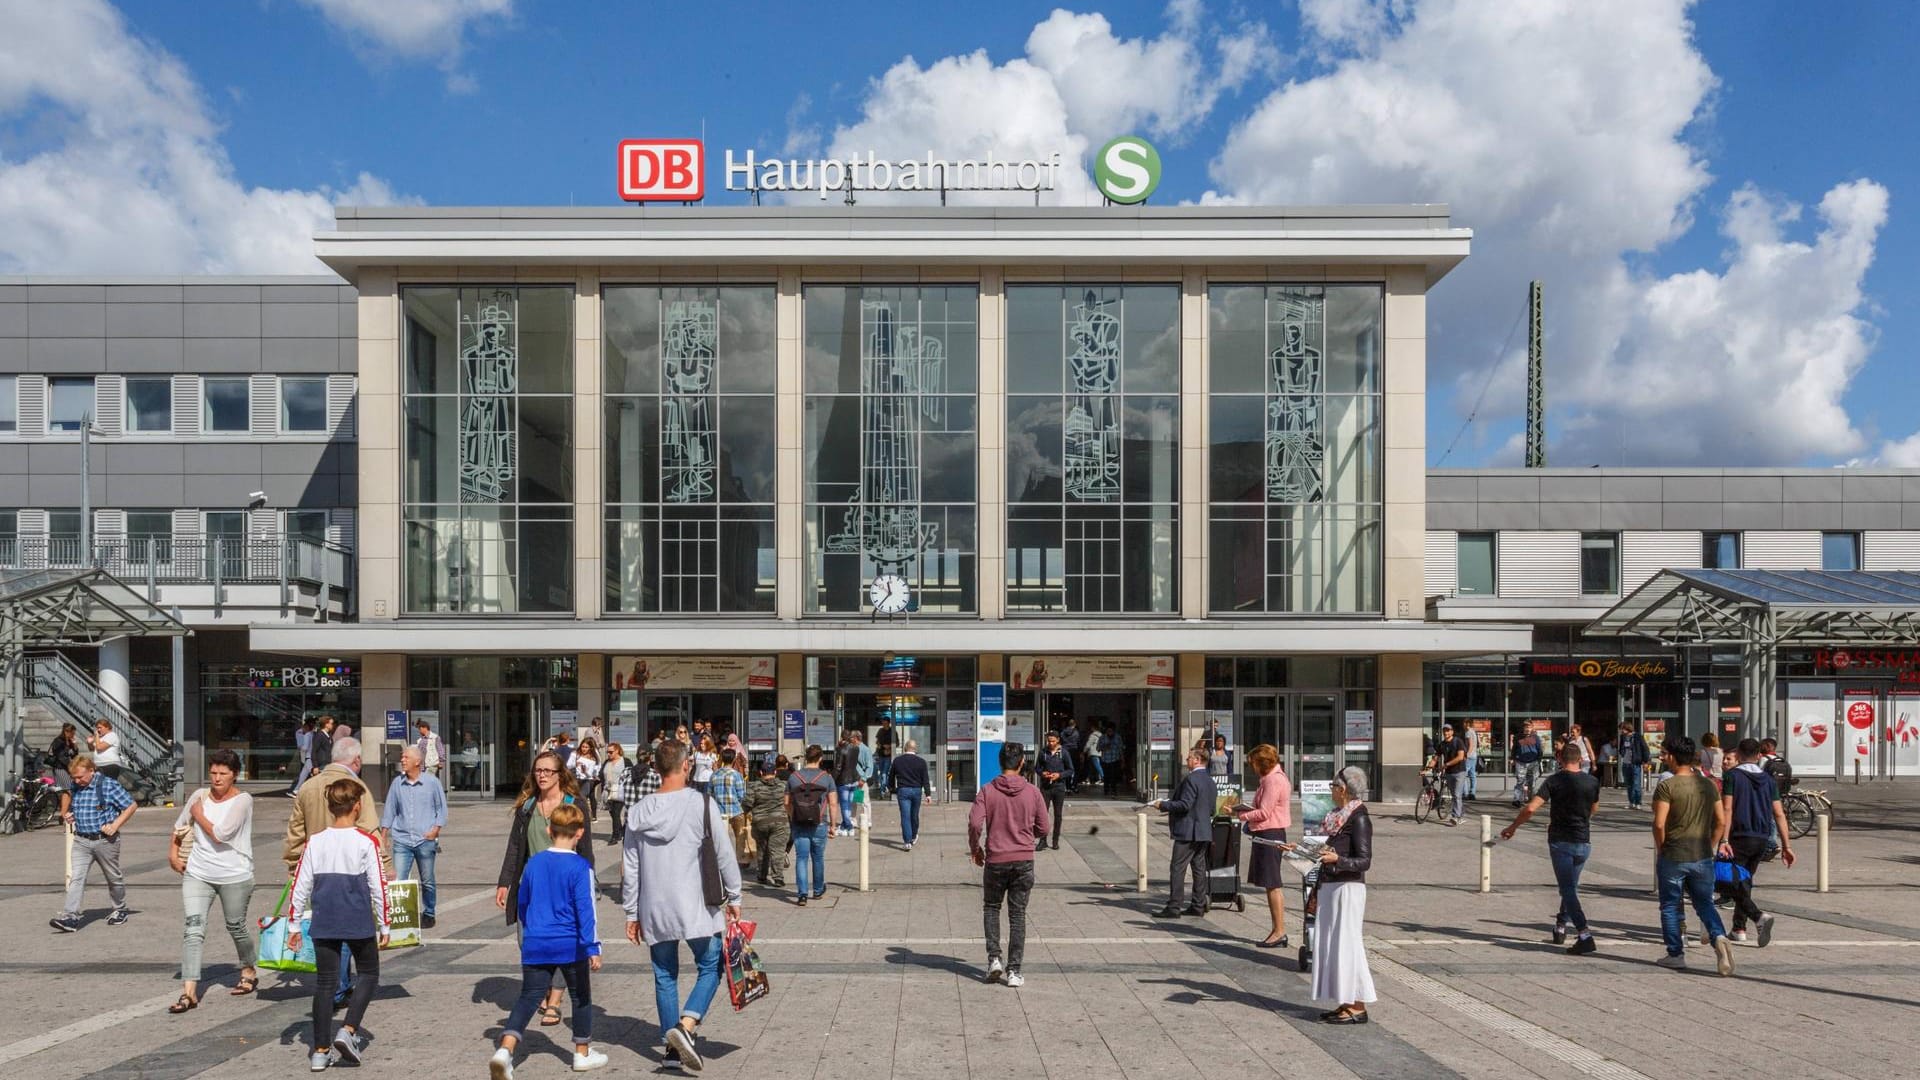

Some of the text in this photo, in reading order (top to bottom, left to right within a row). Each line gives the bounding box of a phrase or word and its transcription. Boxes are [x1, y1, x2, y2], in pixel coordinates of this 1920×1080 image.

[630, 149, 694, 189] DB
[725, 149, 1062, 201] Hauptbahnhof
[1103, 142, 1151, 197] S
[249, 667, 275, 678] Press
[281, 667, 319, 688] P&B
[1601, 659, 1669, 679] Backstube
[320, 677, 351, 687] Books
[388, 906, 407, 915] OOL
